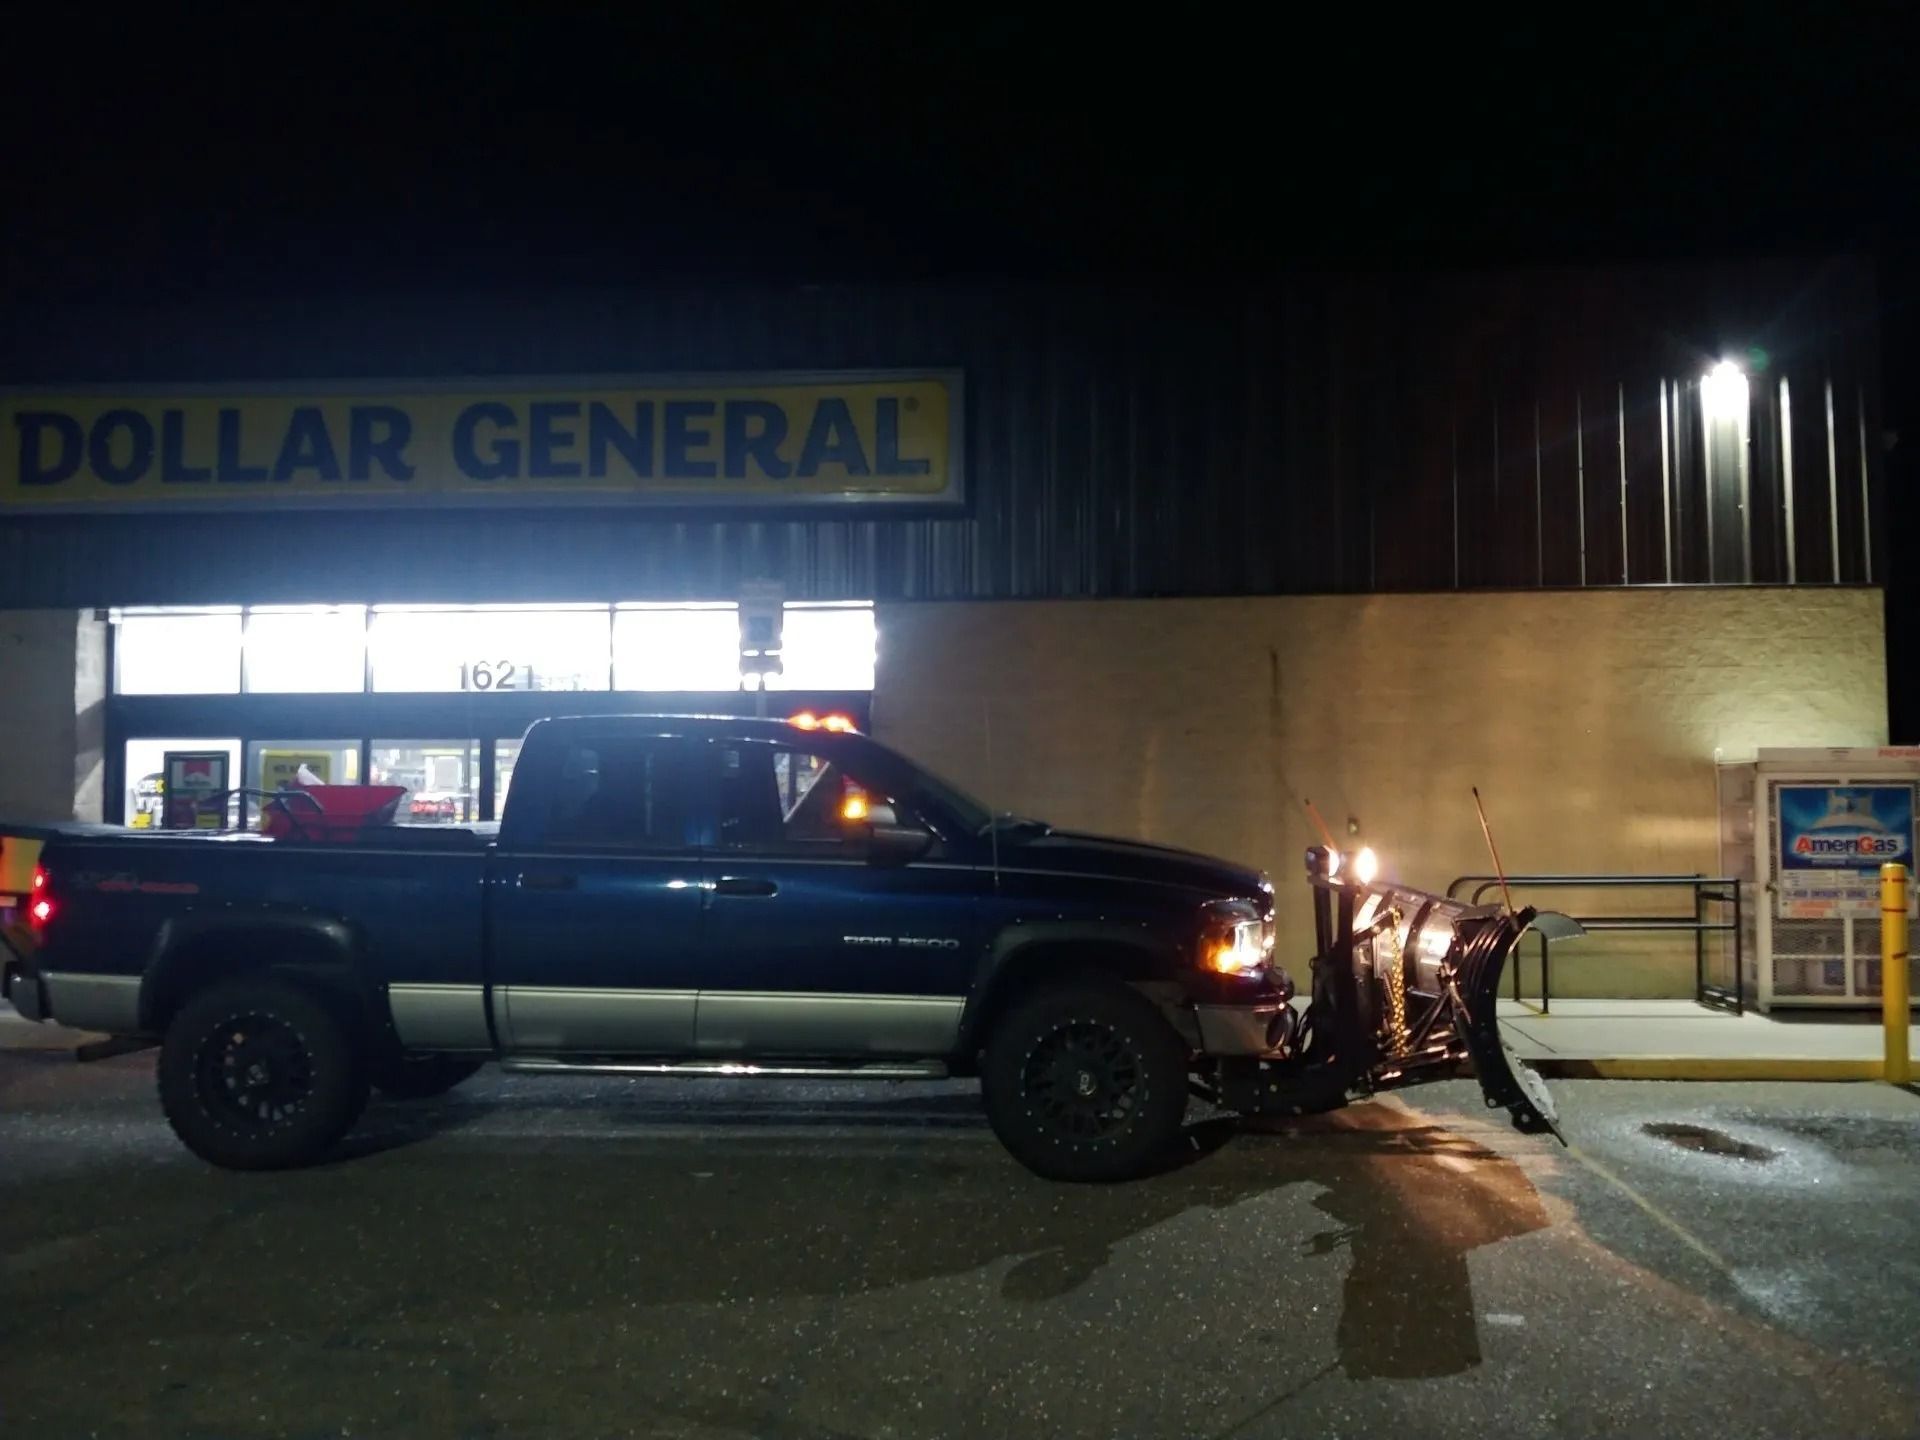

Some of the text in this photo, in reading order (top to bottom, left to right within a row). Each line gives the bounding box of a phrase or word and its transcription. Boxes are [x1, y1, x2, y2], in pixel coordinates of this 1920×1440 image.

[18, 396, 931, 486] DOLLAR GENERAL
[457, 659, 534, 690] 1621
[1794, 834, 1898, 854] AmeriGas
